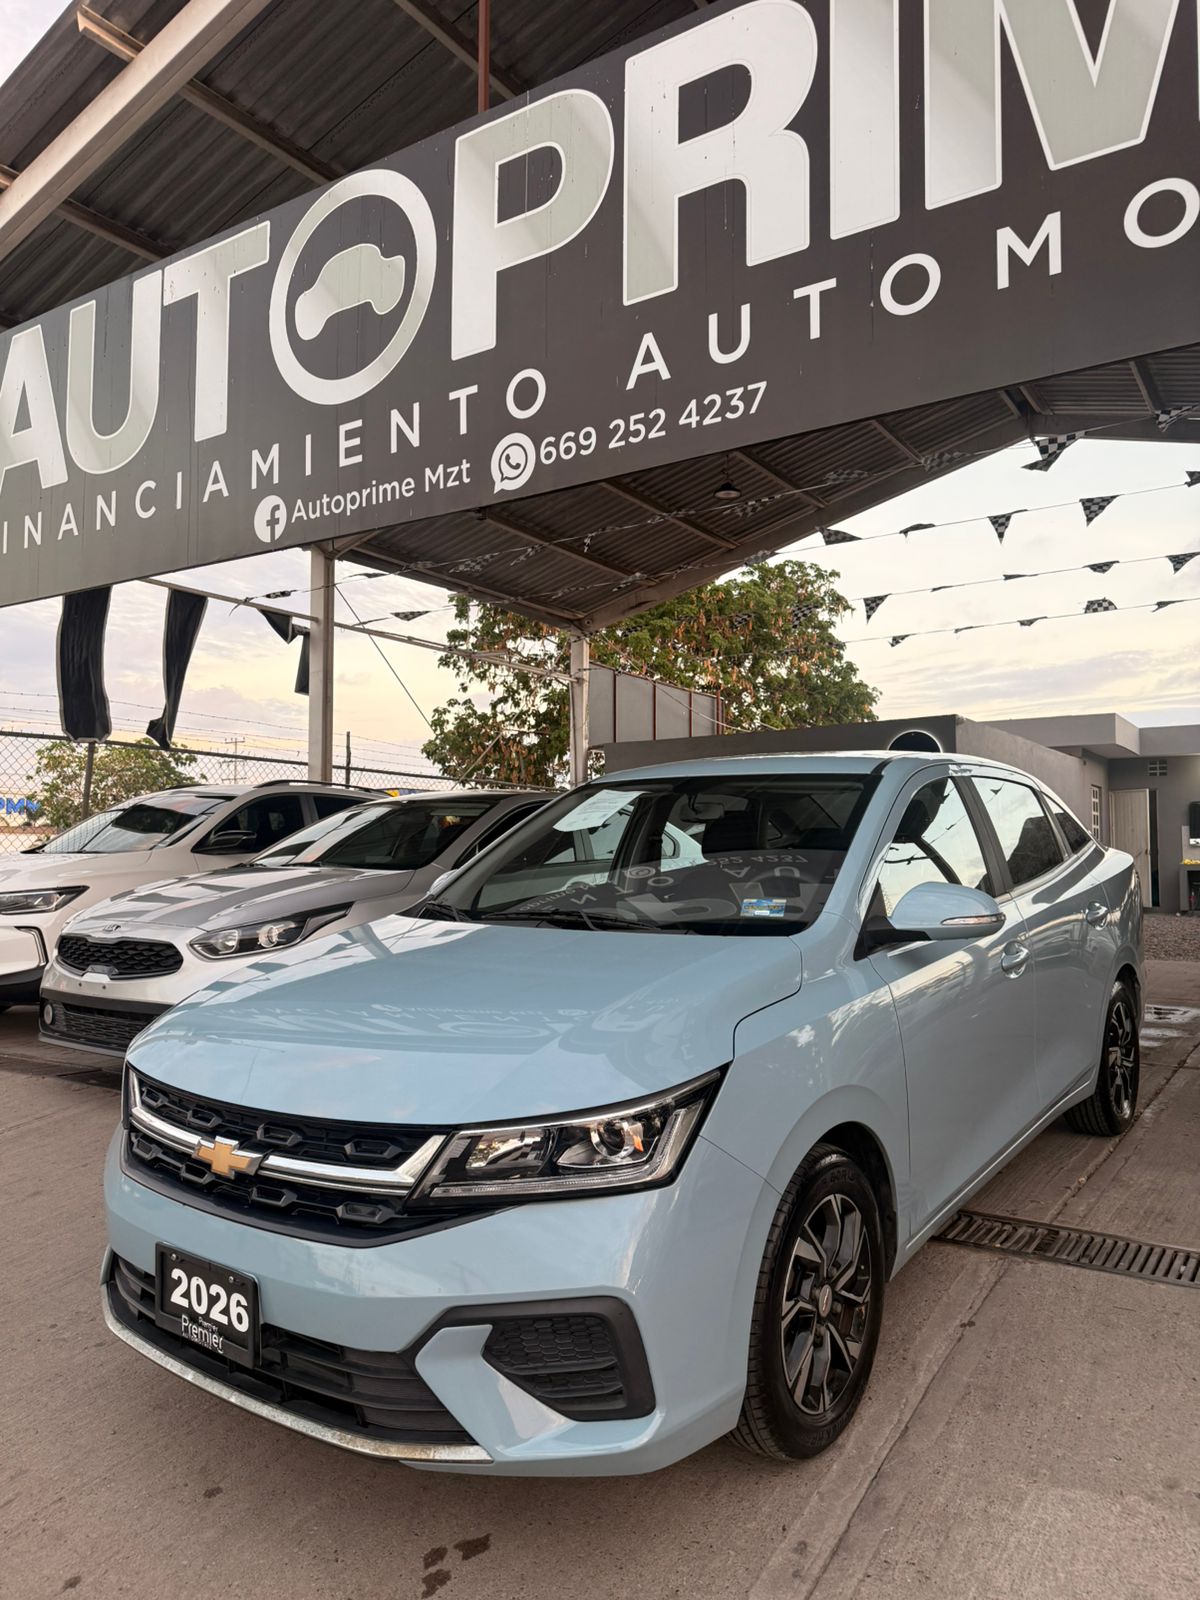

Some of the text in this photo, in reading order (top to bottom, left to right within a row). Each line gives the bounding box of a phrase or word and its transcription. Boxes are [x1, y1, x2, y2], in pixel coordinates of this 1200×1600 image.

[626, 177, 1200, 390] AUTOMO
[539, 380, 767, 465] 669 252 4237
[291, 476, 415, 523] Autoprime
[424, 458, 471, 493] Mzt
[170, 1267, 250, 1333] 2026
[181, 1314, 224, 1351] Premier
